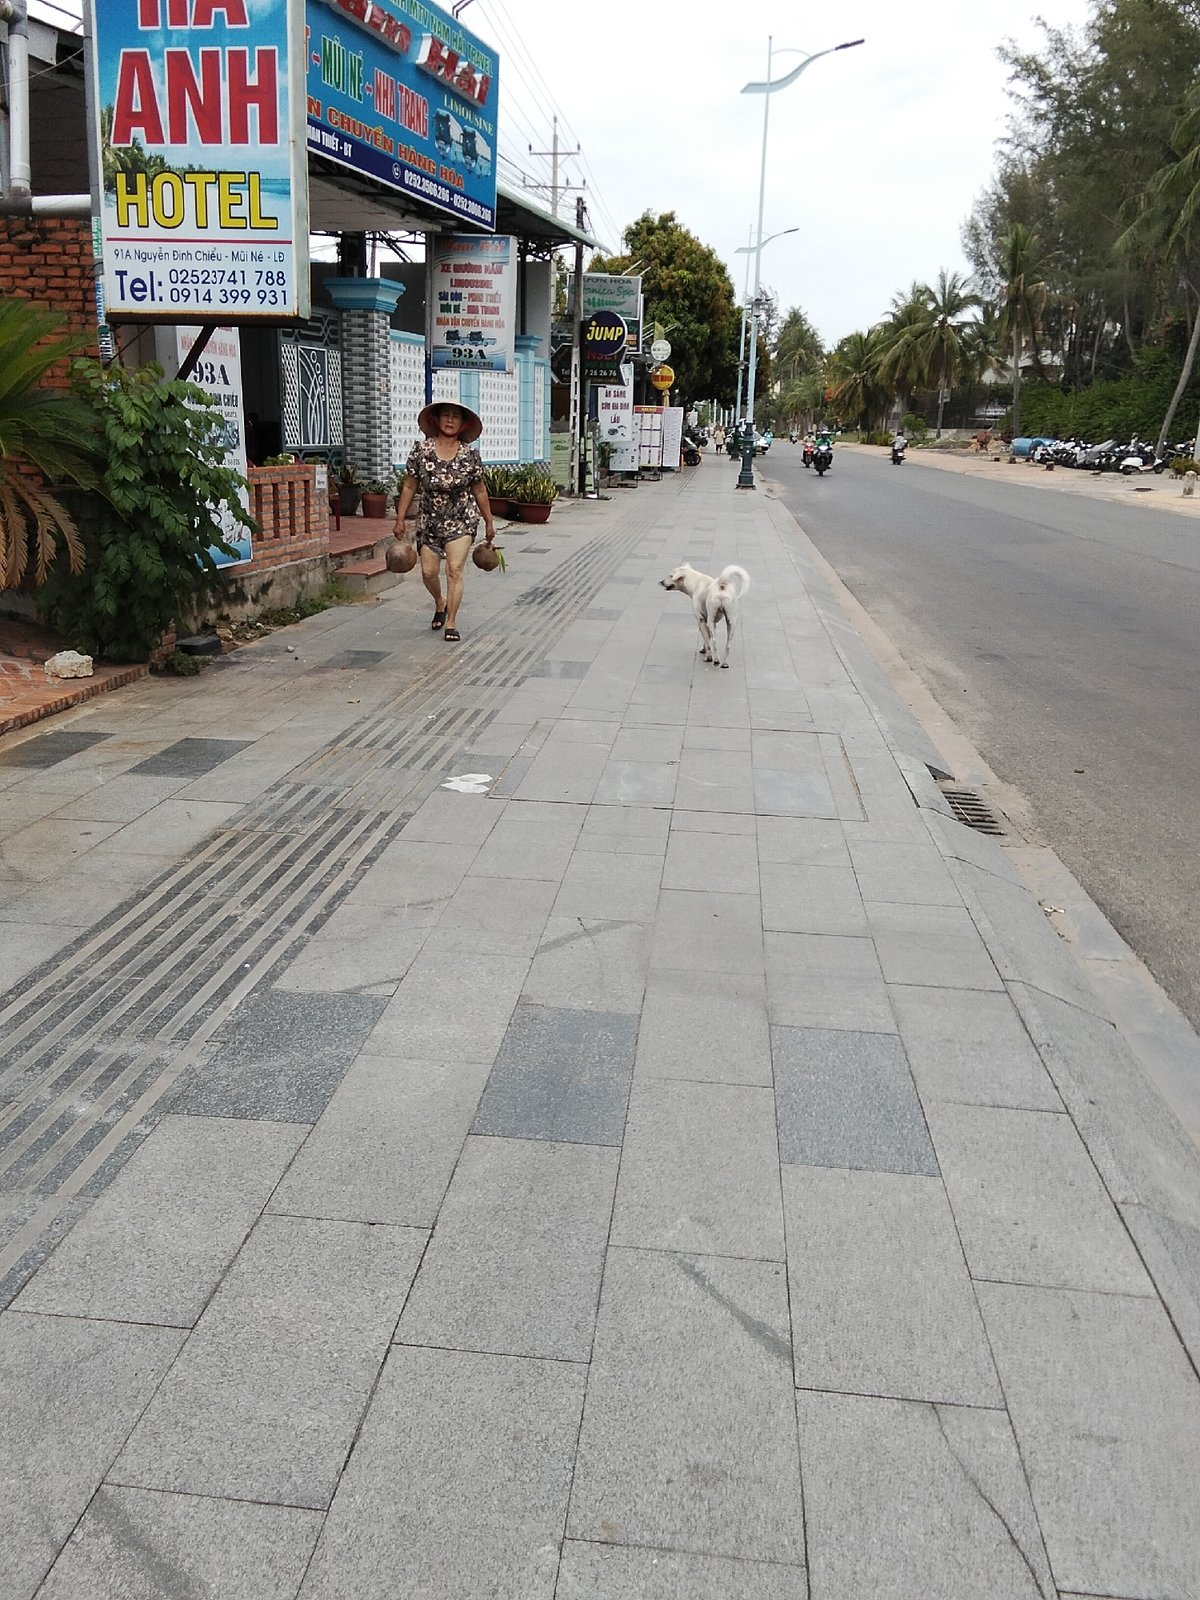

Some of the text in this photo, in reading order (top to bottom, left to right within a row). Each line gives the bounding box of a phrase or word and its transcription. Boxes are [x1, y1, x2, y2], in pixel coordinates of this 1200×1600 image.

[430, 12, 451, 46] NAM
[467, 41, 493, 78] TRAVEL
[110, 45, 279, 147] ANH
[321, 34, 346, 94] MŨI
[348, 50, 364, 104] NÉ
[373, 67, 396, 122] NHA
[397, 81, 429, 140] TRANG
[444, 93, 494, 136] LIMOUSINE
[321, 131, 340, 153] THIẾT
[397, 142, 437, 176] HÀNG
[439, 164, 464, 191] HÓA
[115, 170, 279, 230] HOTEL
[114, 248, 131, 260] 91A
[134, 247, 169, 263] Nguyễn
[194, 247, 222, 261] Chiểu
[231, 249, 248, 261] Mũi
[251, 250, 263, 262] Né
[274, 252, 285, 262] LĐ
[440, 263, 451, 273] XE
[115, 270, 163, 302] Tel:
[169, 269, 286, 286] 02523741 788
[170, 288, 287, 305] 0914 399 931
[452, 347, 487, 359] 93A
[191, 361, 230, 385] 93A
